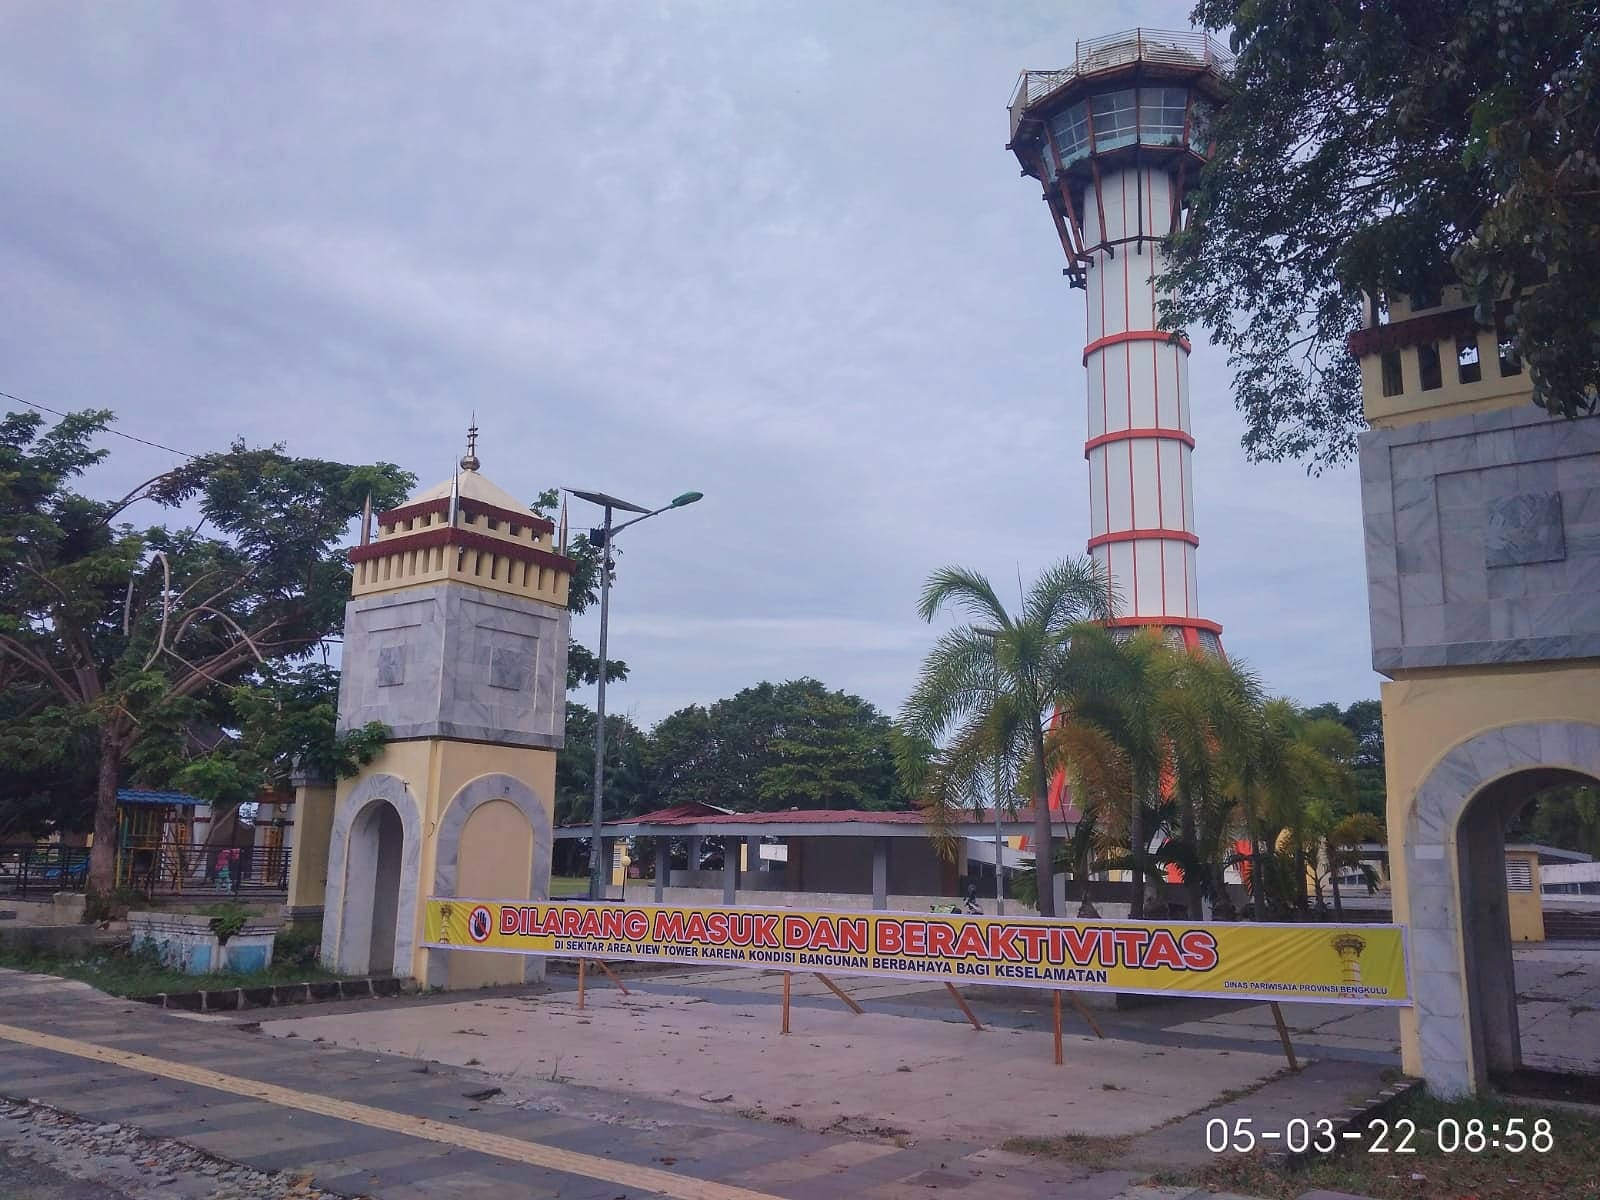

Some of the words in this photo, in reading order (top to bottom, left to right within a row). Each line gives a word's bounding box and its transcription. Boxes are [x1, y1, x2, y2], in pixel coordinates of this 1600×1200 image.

[500, 906, 649, 941] DILARANG
[653, 912, 780, 947] MASUK
[784, 915, 869, 953] DAN
[875, 918, 1219, 971] BERAKTIVITAS
[554, 940, 564, 950] DI
[566, 941, 604, 952] SEKITAR
[606, 942, 632, 953] AREA
[635, 944, 660, 955] VIEW
[663, 945, 698, 957] TOWER
[701, 948, 745, 961] KARENA
[749, 950, 795, 963] KONDISI
[799, 953, 869, 969] BANGUNAN
[872, 957, 952, 974] BERBAHAYA
[956, 962, 990, 976] BAGI
[994, 964, 1107, 983] KESELAMATAN
[1224, 980, 1248, 990] DINAS
[1250, 982, 1297, 992] PARIWISATA
[1299, 984, 1339, 993] PROVINSI
[1340, 986, 1388, 995] BENGKULU
